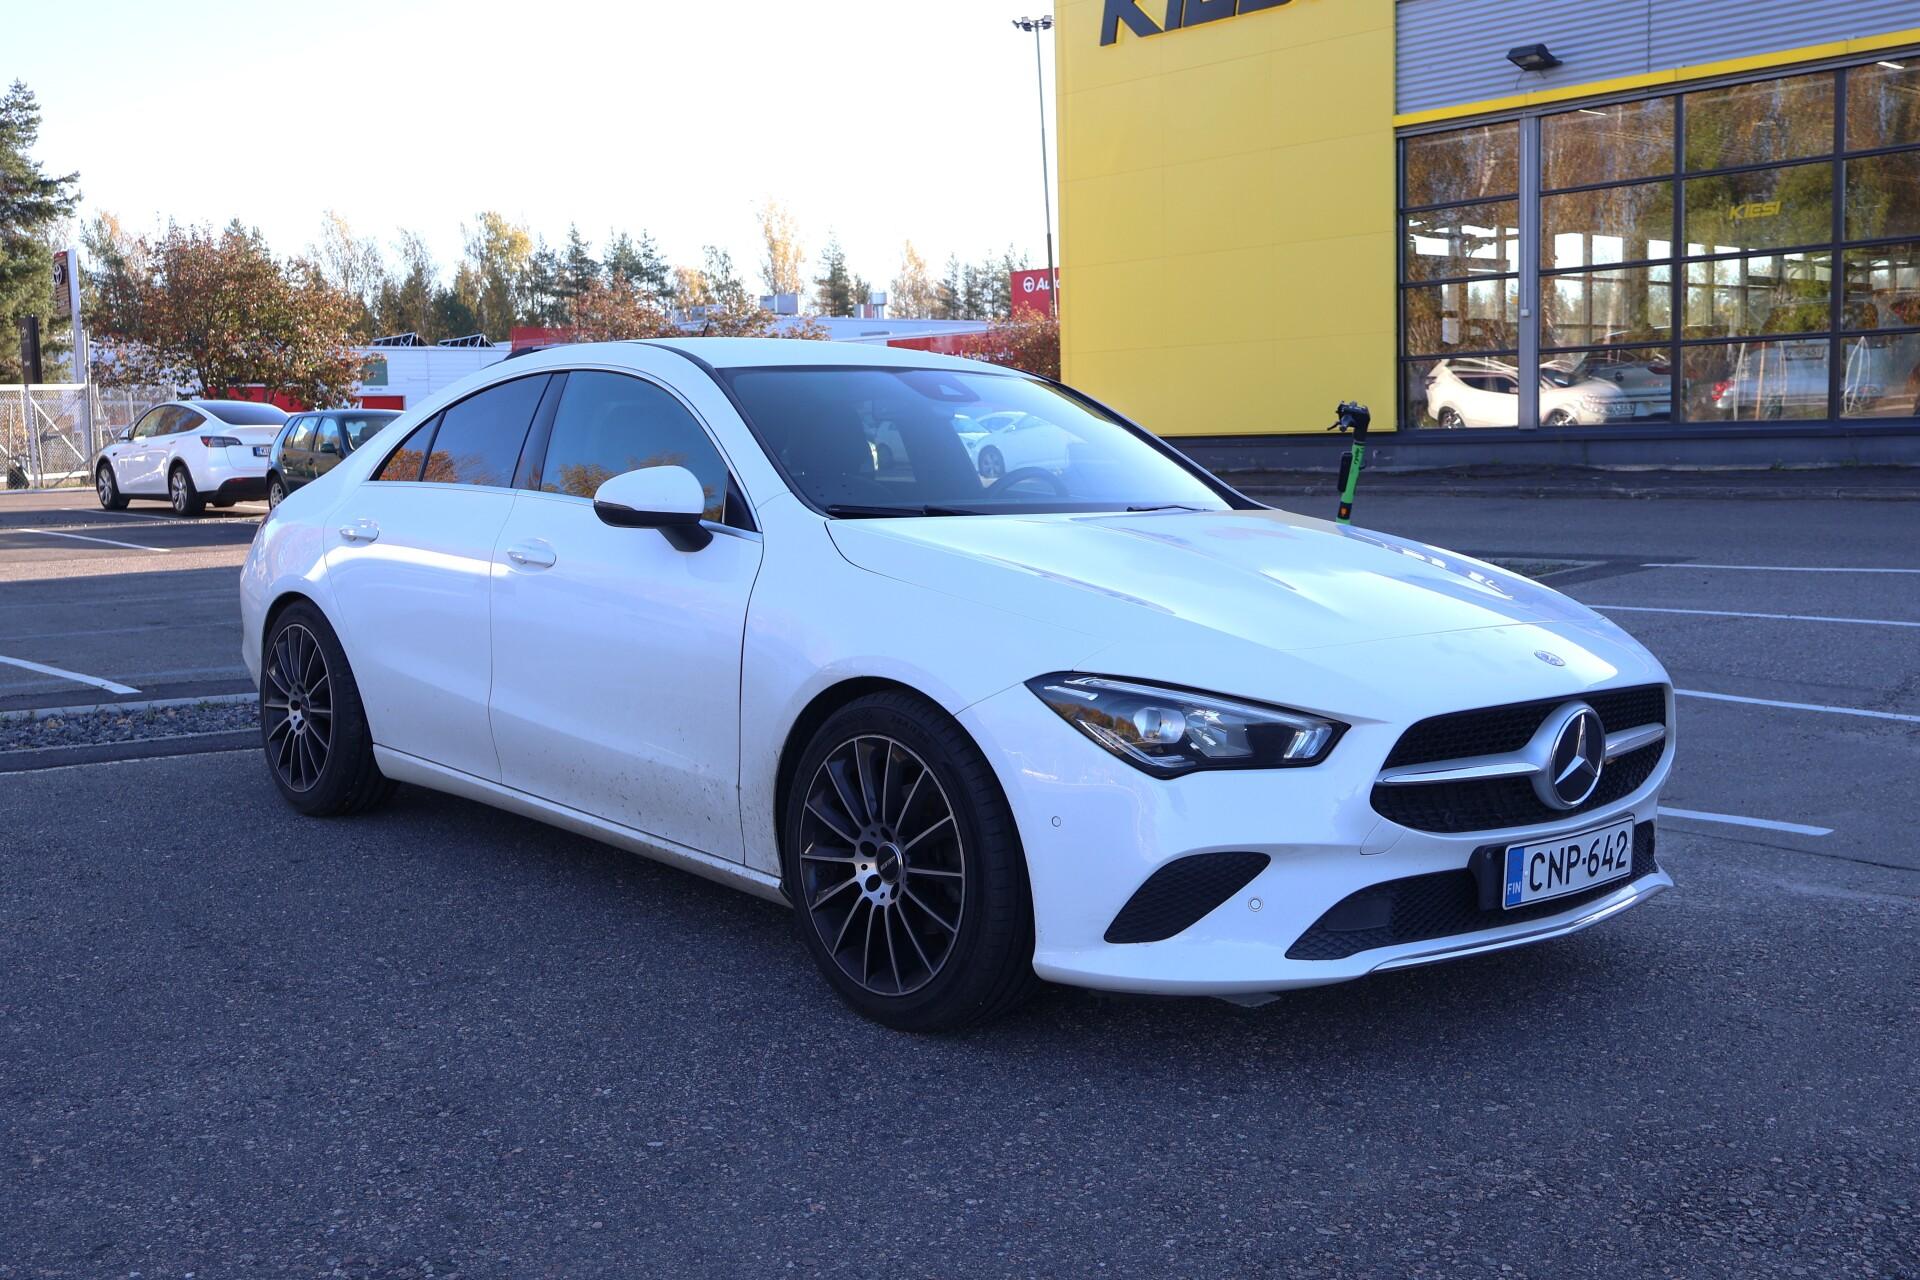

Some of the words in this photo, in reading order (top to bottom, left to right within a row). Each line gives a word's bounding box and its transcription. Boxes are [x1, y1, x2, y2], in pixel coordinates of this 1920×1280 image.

[1729, 201, 1781, 220] KIESI
[1530, 831, 1628, 891] CNP-642
[1507, 880, 1522, 895] FIN
